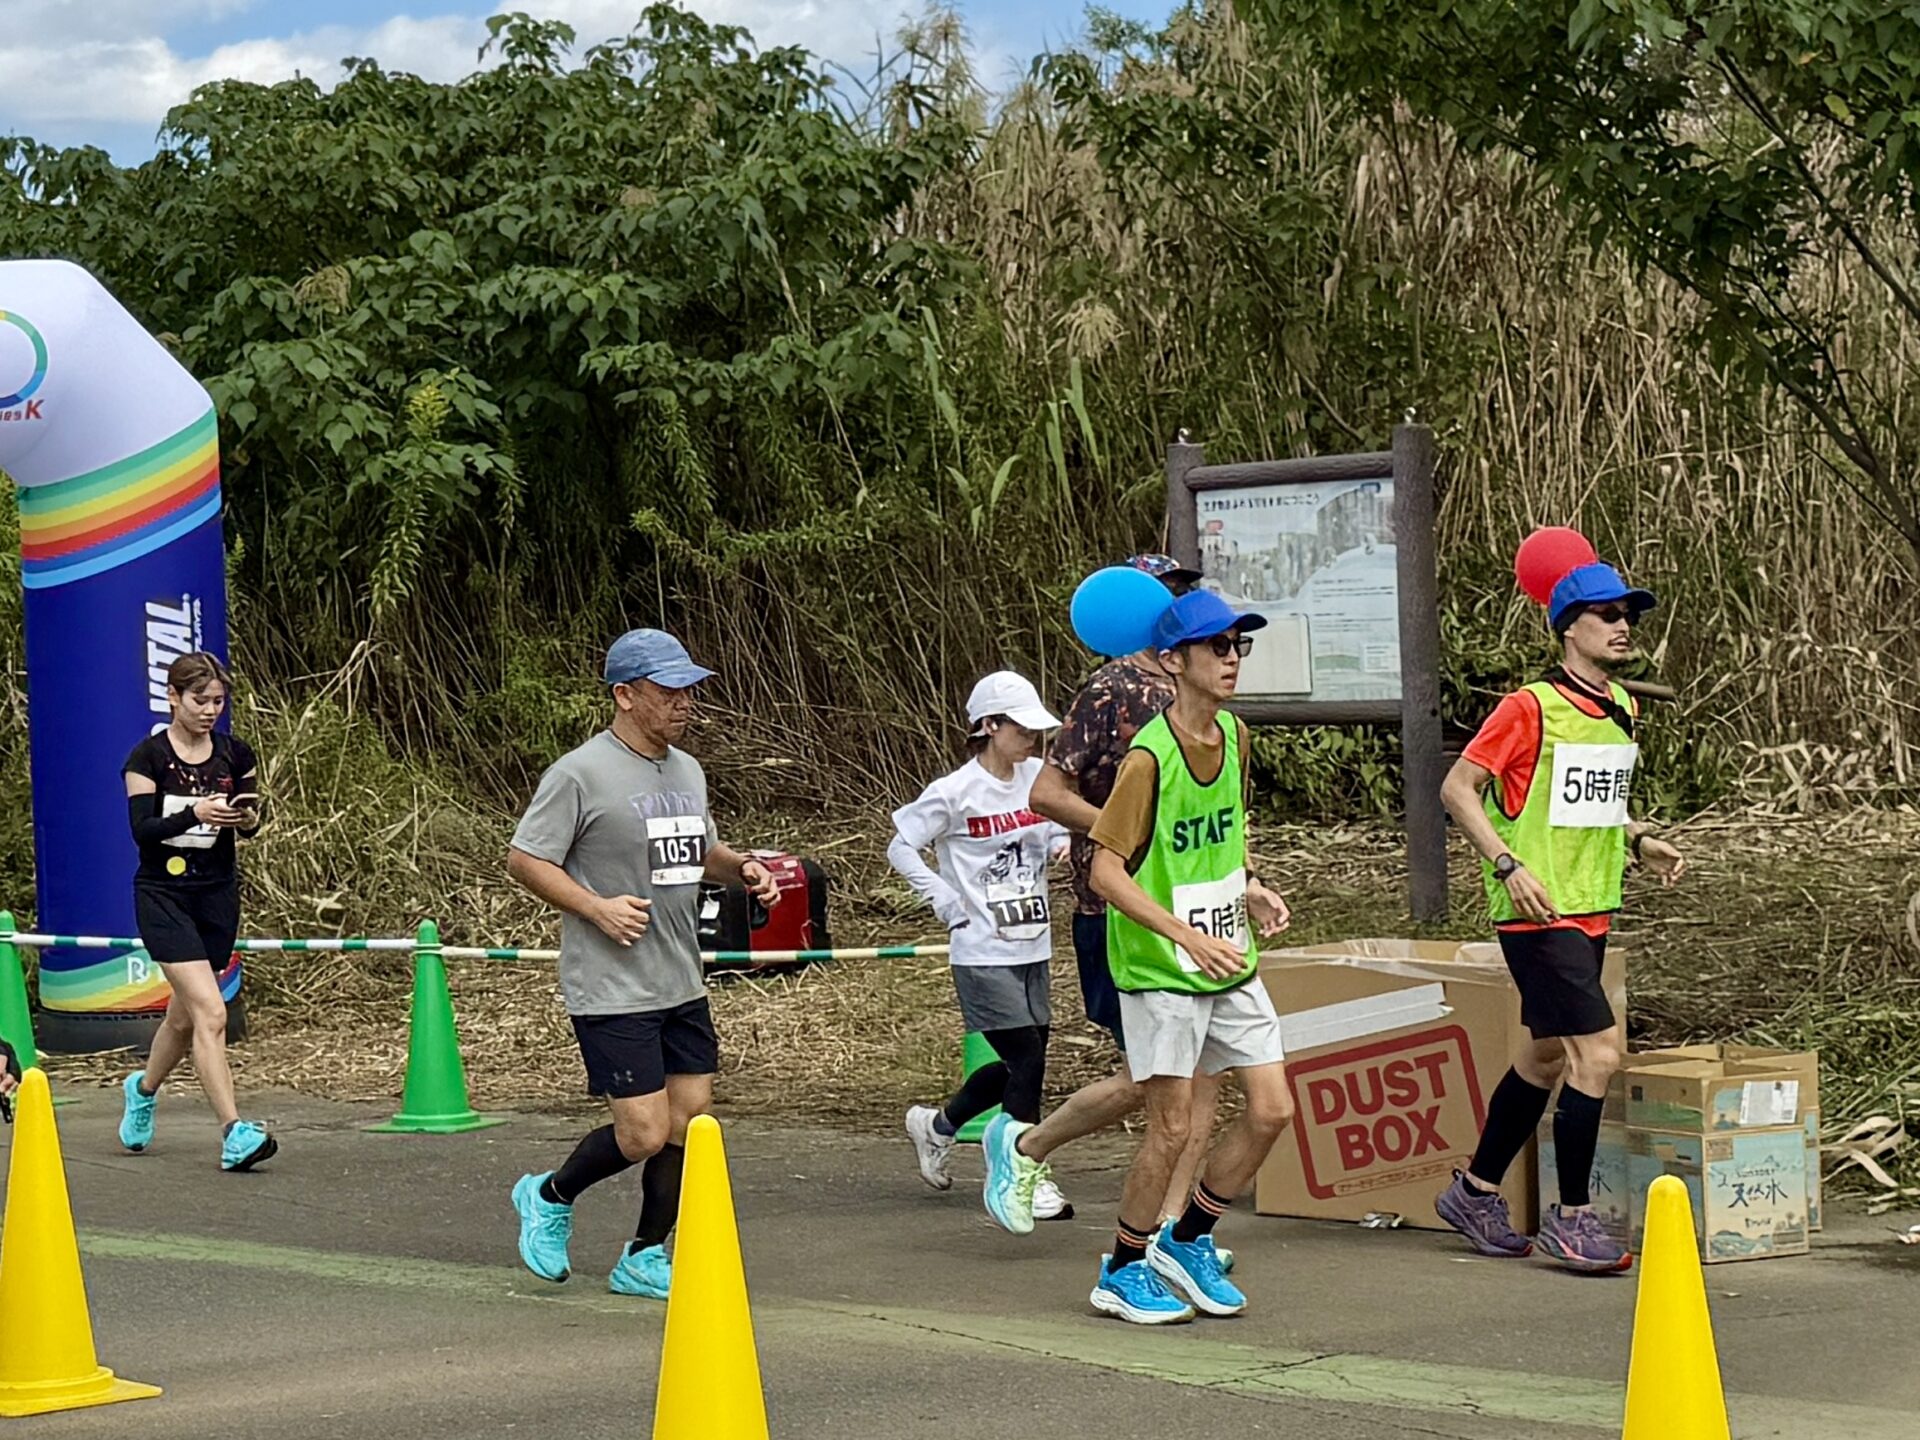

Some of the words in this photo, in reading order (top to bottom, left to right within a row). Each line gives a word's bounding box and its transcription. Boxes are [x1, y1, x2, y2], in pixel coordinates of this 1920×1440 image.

[654, 837, 701, 864] 1051
[1306, 1050, 1450, 1126] DUST
[1335, 1105, 1451, 1171] BOX
